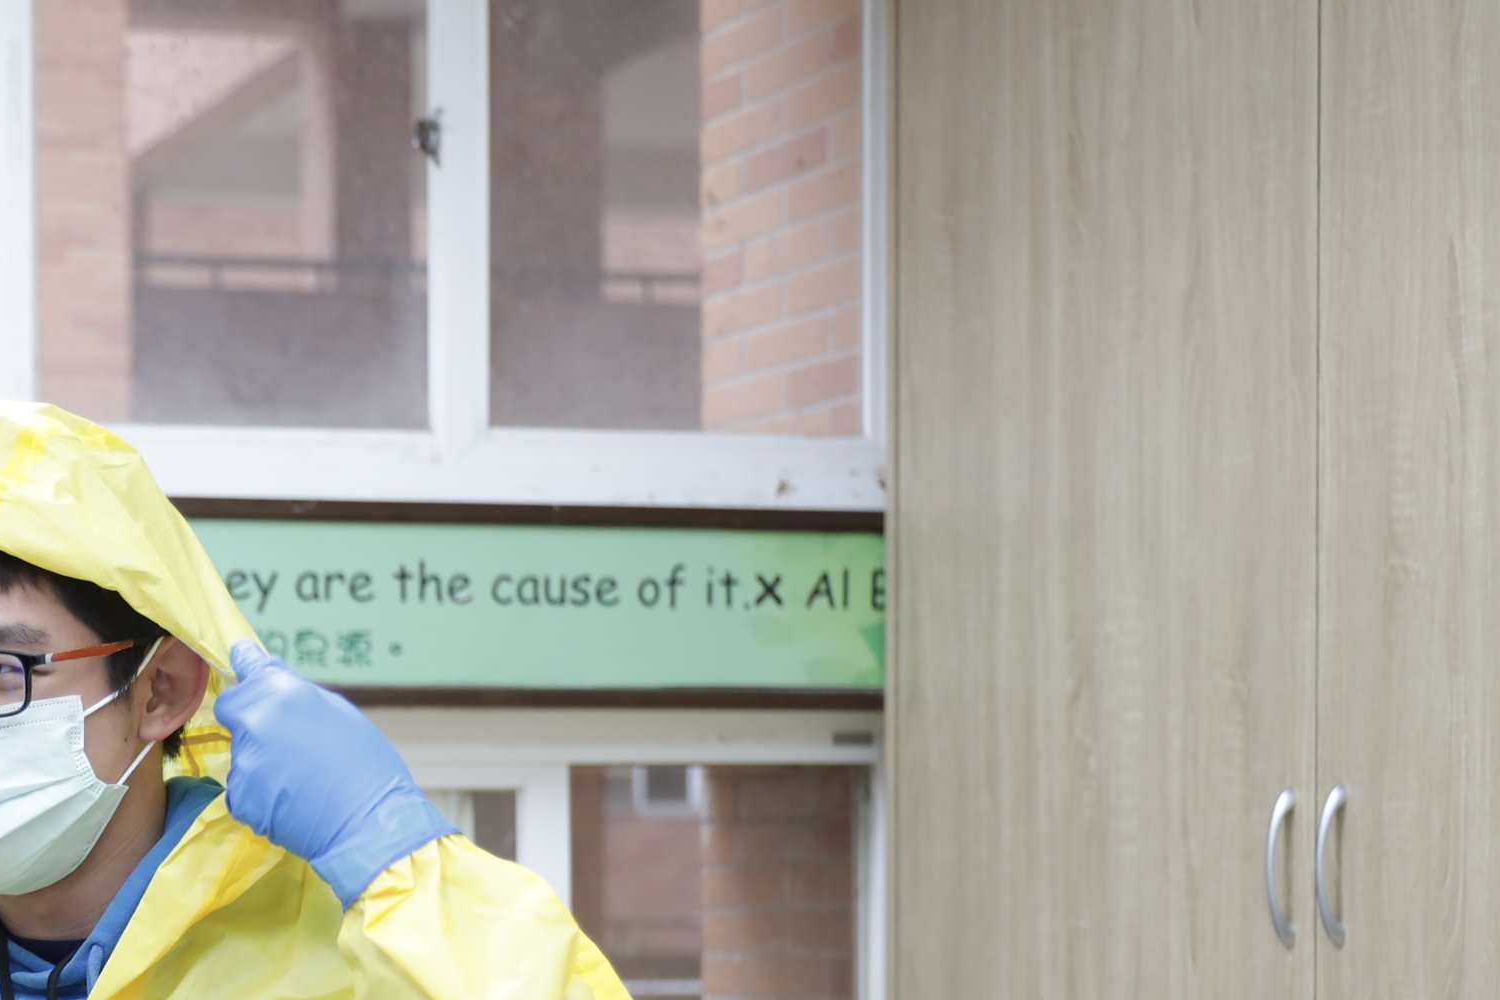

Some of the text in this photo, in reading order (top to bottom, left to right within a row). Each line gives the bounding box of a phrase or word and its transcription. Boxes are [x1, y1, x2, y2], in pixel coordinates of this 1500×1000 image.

[226, 569, 278, 614] ey
[295, 570, 375, 602] are
[393, 559, 471, 604] the
[492, 571, 619, 607] cause
[638, 563, 686, 609] of
